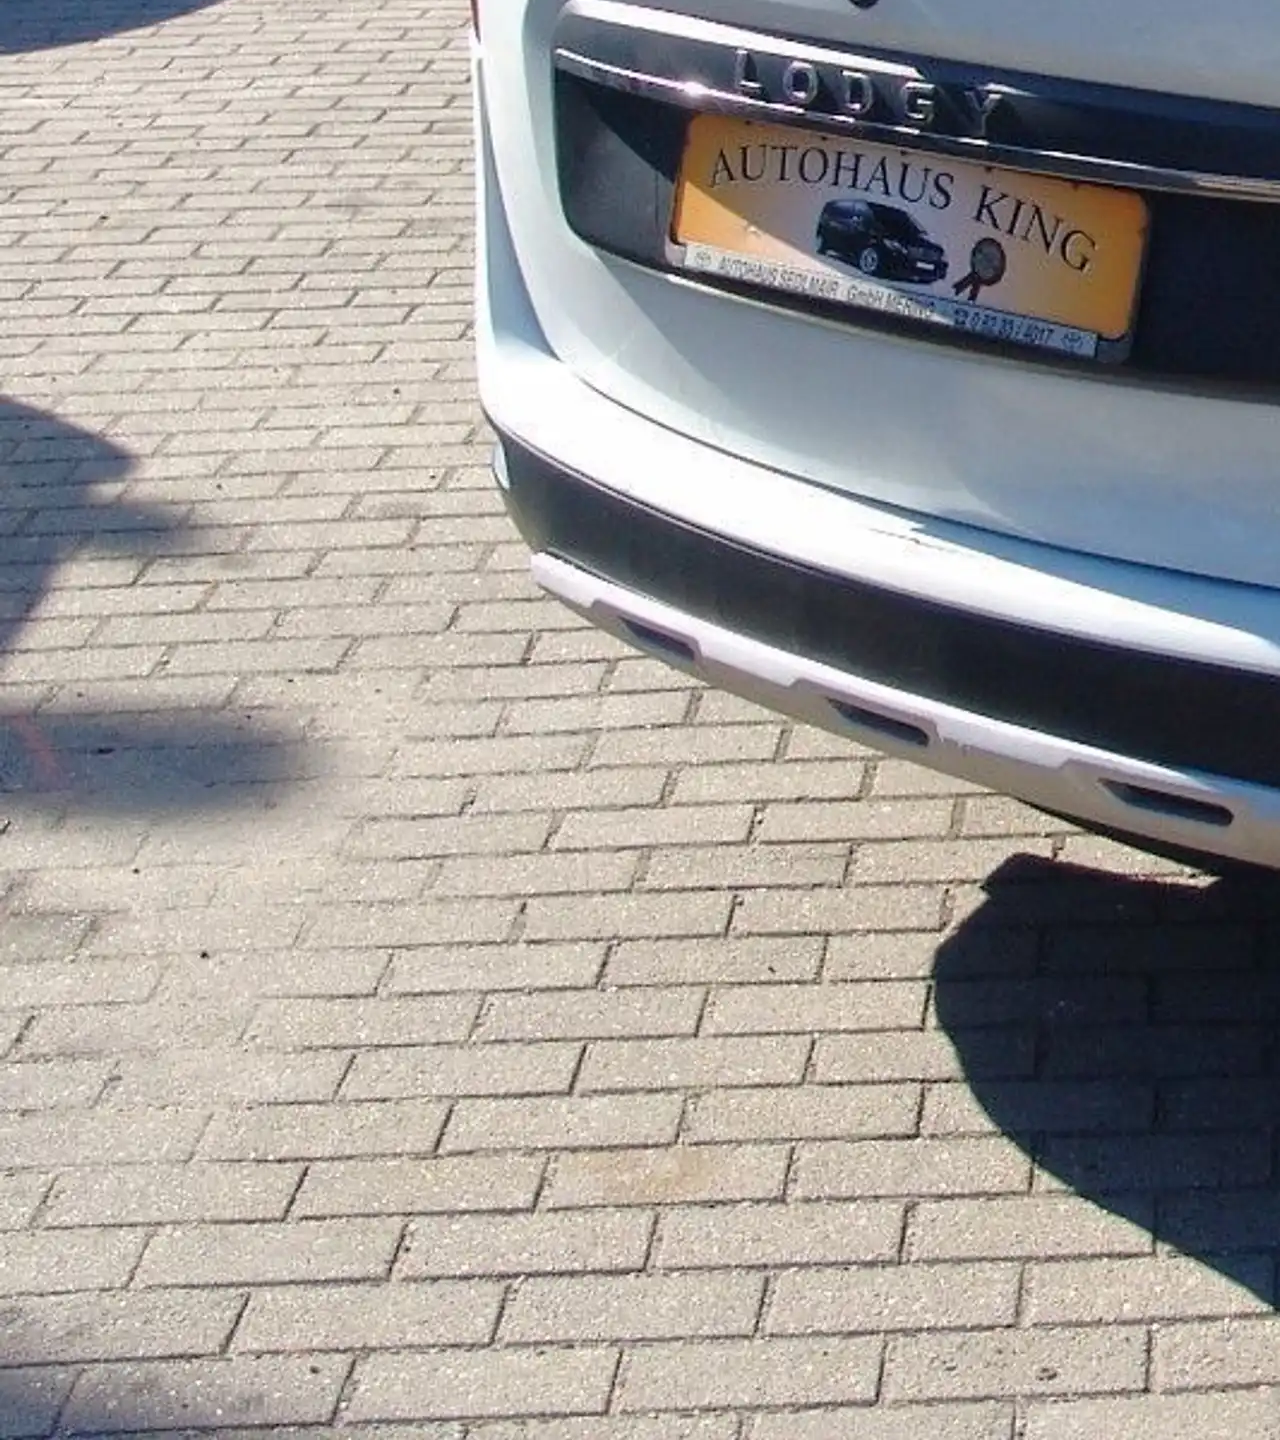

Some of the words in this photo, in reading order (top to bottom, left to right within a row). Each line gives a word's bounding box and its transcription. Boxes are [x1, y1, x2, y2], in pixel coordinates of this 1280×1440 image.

[735, 48, 1004, 137] LODGY
[709, 144, 955, 211] AUTOHAUS
[975, 183, 1099, 275] KING
